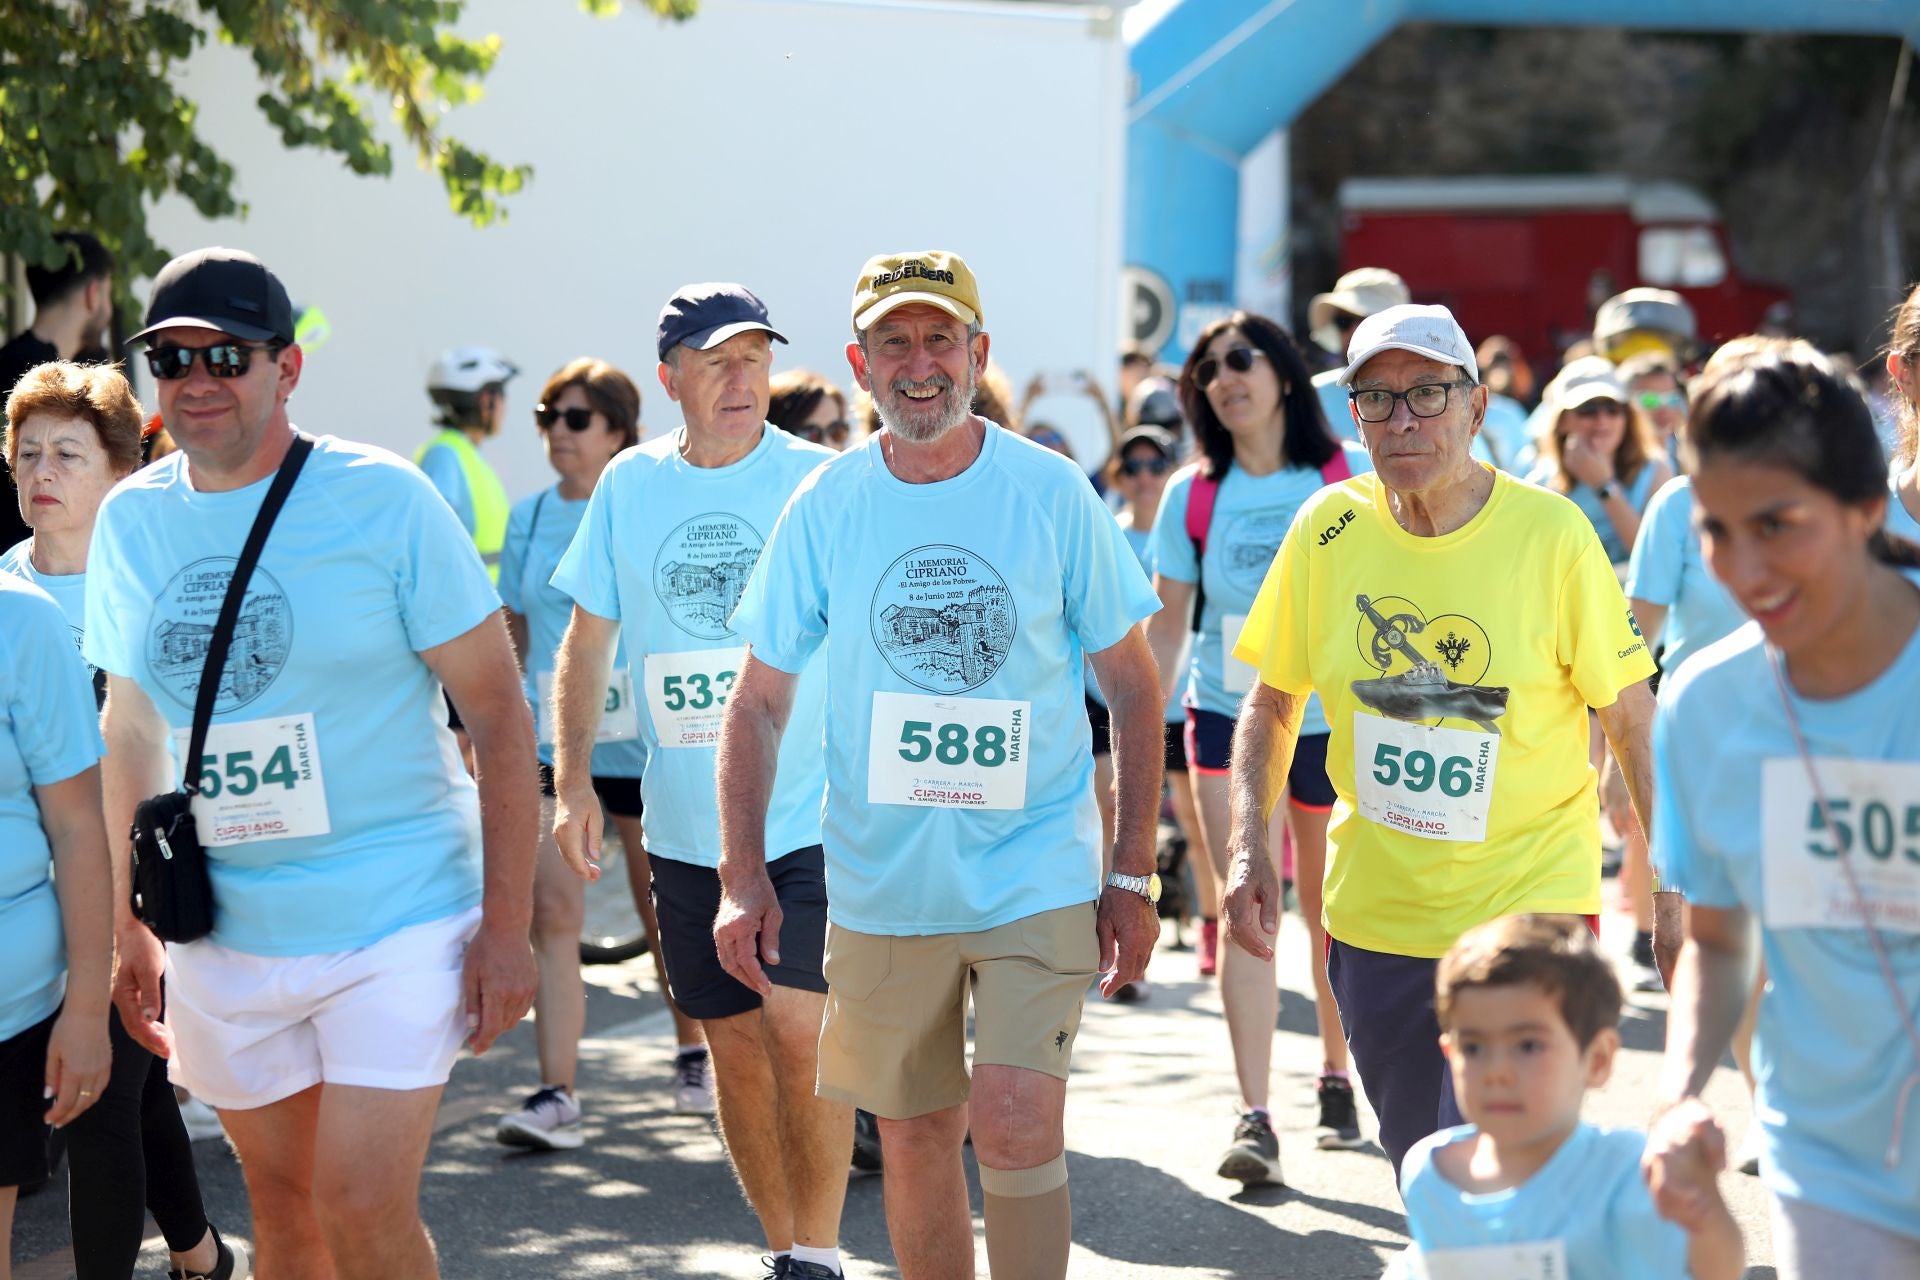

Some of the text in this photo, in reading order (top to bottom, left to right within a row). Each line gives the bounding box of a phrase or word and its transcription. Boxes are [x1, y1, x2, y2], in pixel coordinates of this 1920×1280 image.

[873, 265, 954, 289] HEIDELBERG
[698, 523, 739, 532] MEMORIAL
[686, 530, 738, 541] CIPRIANO
[701, 552, 718, 560] Junio
[719, 551, 732, 559] 2025
[918, 557, 969, 568] MEMORIAL
[905, 566, 967, 579] CIPRIANO
[183, 580, 229, 593] CIPRIA
[908, 580, 931, 589] Amigo
[941, 578, 952, 586] los
[915, 593, 924, 601] de
[924, 592, 945, 602] Junio
[946, 590, 964, 599] 2025
[1009, 708, 1023, 762] MARCHA
[898, 720, 1007, 768] 588
[295, 722, 313, 781] MARCHA
[198, 744, 300, 800] 554
[1372, 742, 1474, 798] 596
[1474, 740, 1491, 793] MARCHA
[958, 781, 983, 789] MARCHA
[914, 789, 983, 801] CIPRIANO
[1387, 811, 1445, 830] CIPRIANO
[214, 820, 284, 837] CIPRIANO
